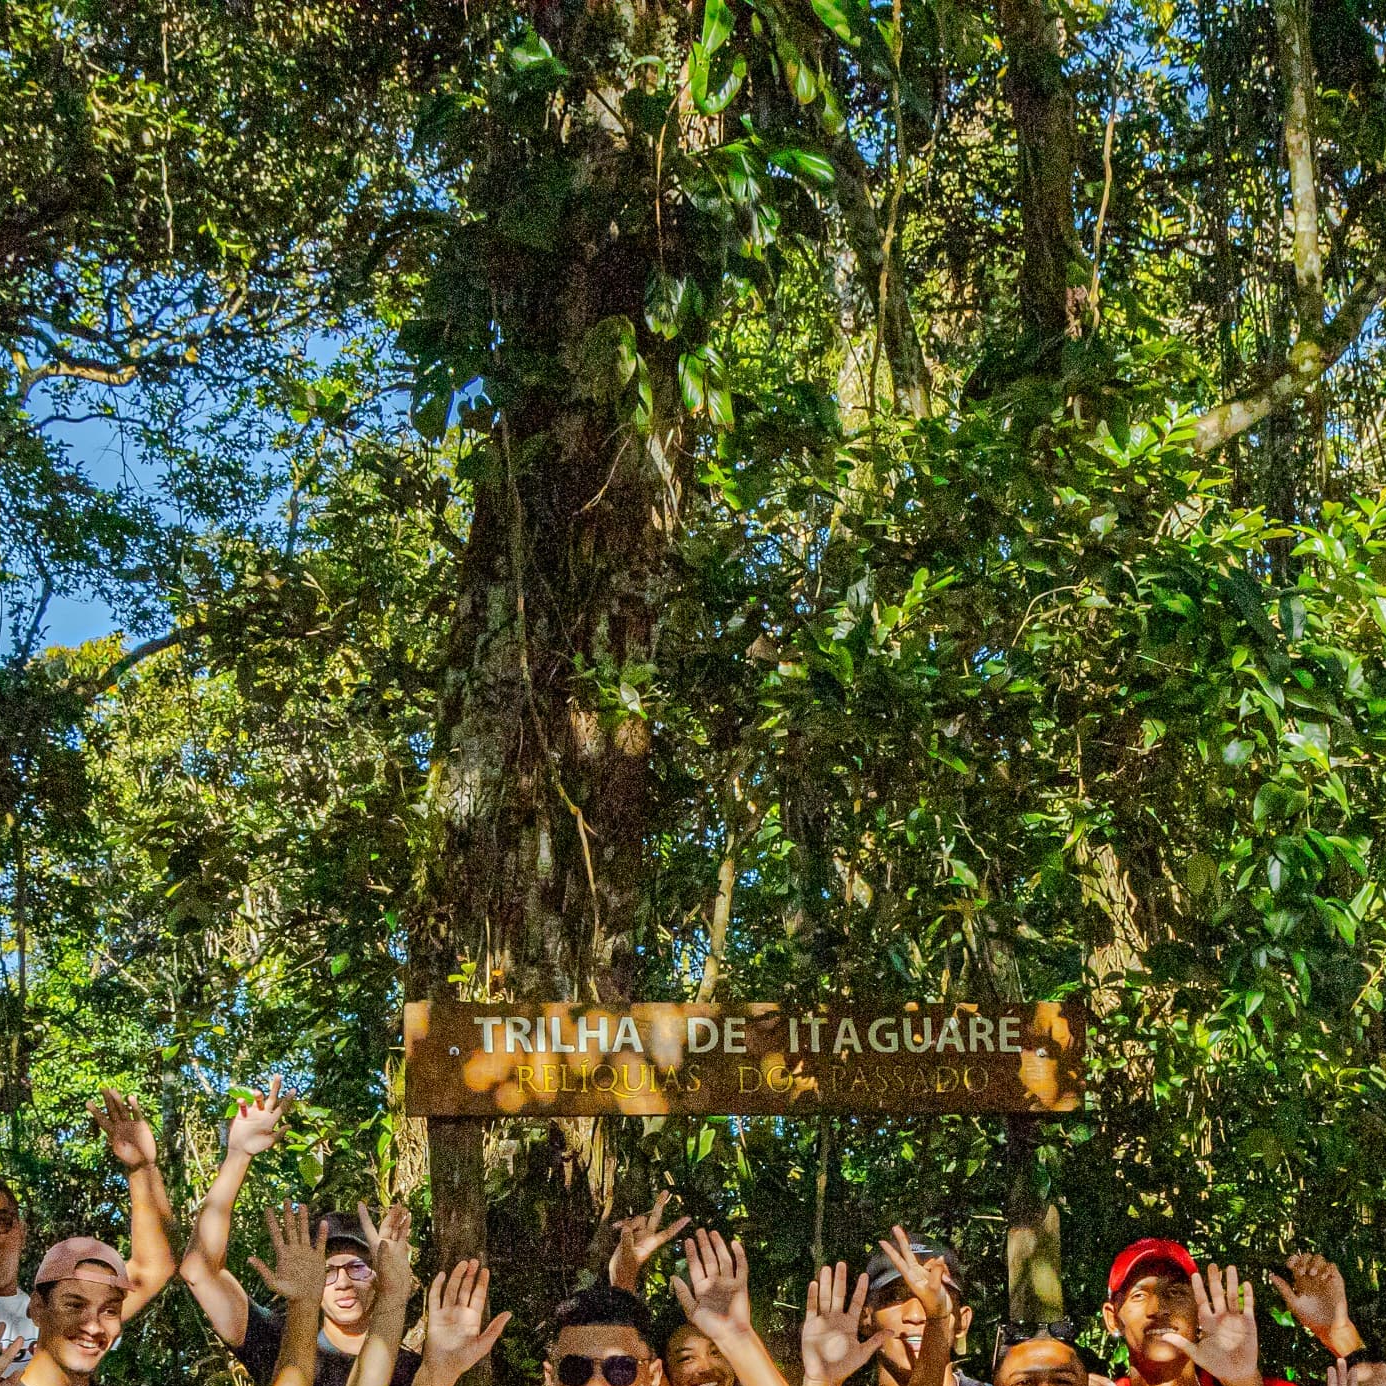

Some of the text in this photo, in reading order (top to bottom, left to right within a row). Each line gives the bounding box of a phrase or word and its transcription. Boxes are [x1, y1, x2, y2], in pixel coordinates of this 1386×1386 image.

[473, 1009, 1023, 1054] TRILHA DE ITAGUARÉ
[516, 1059, 990, 1098] RELÍQUIAS DO PASSADO
